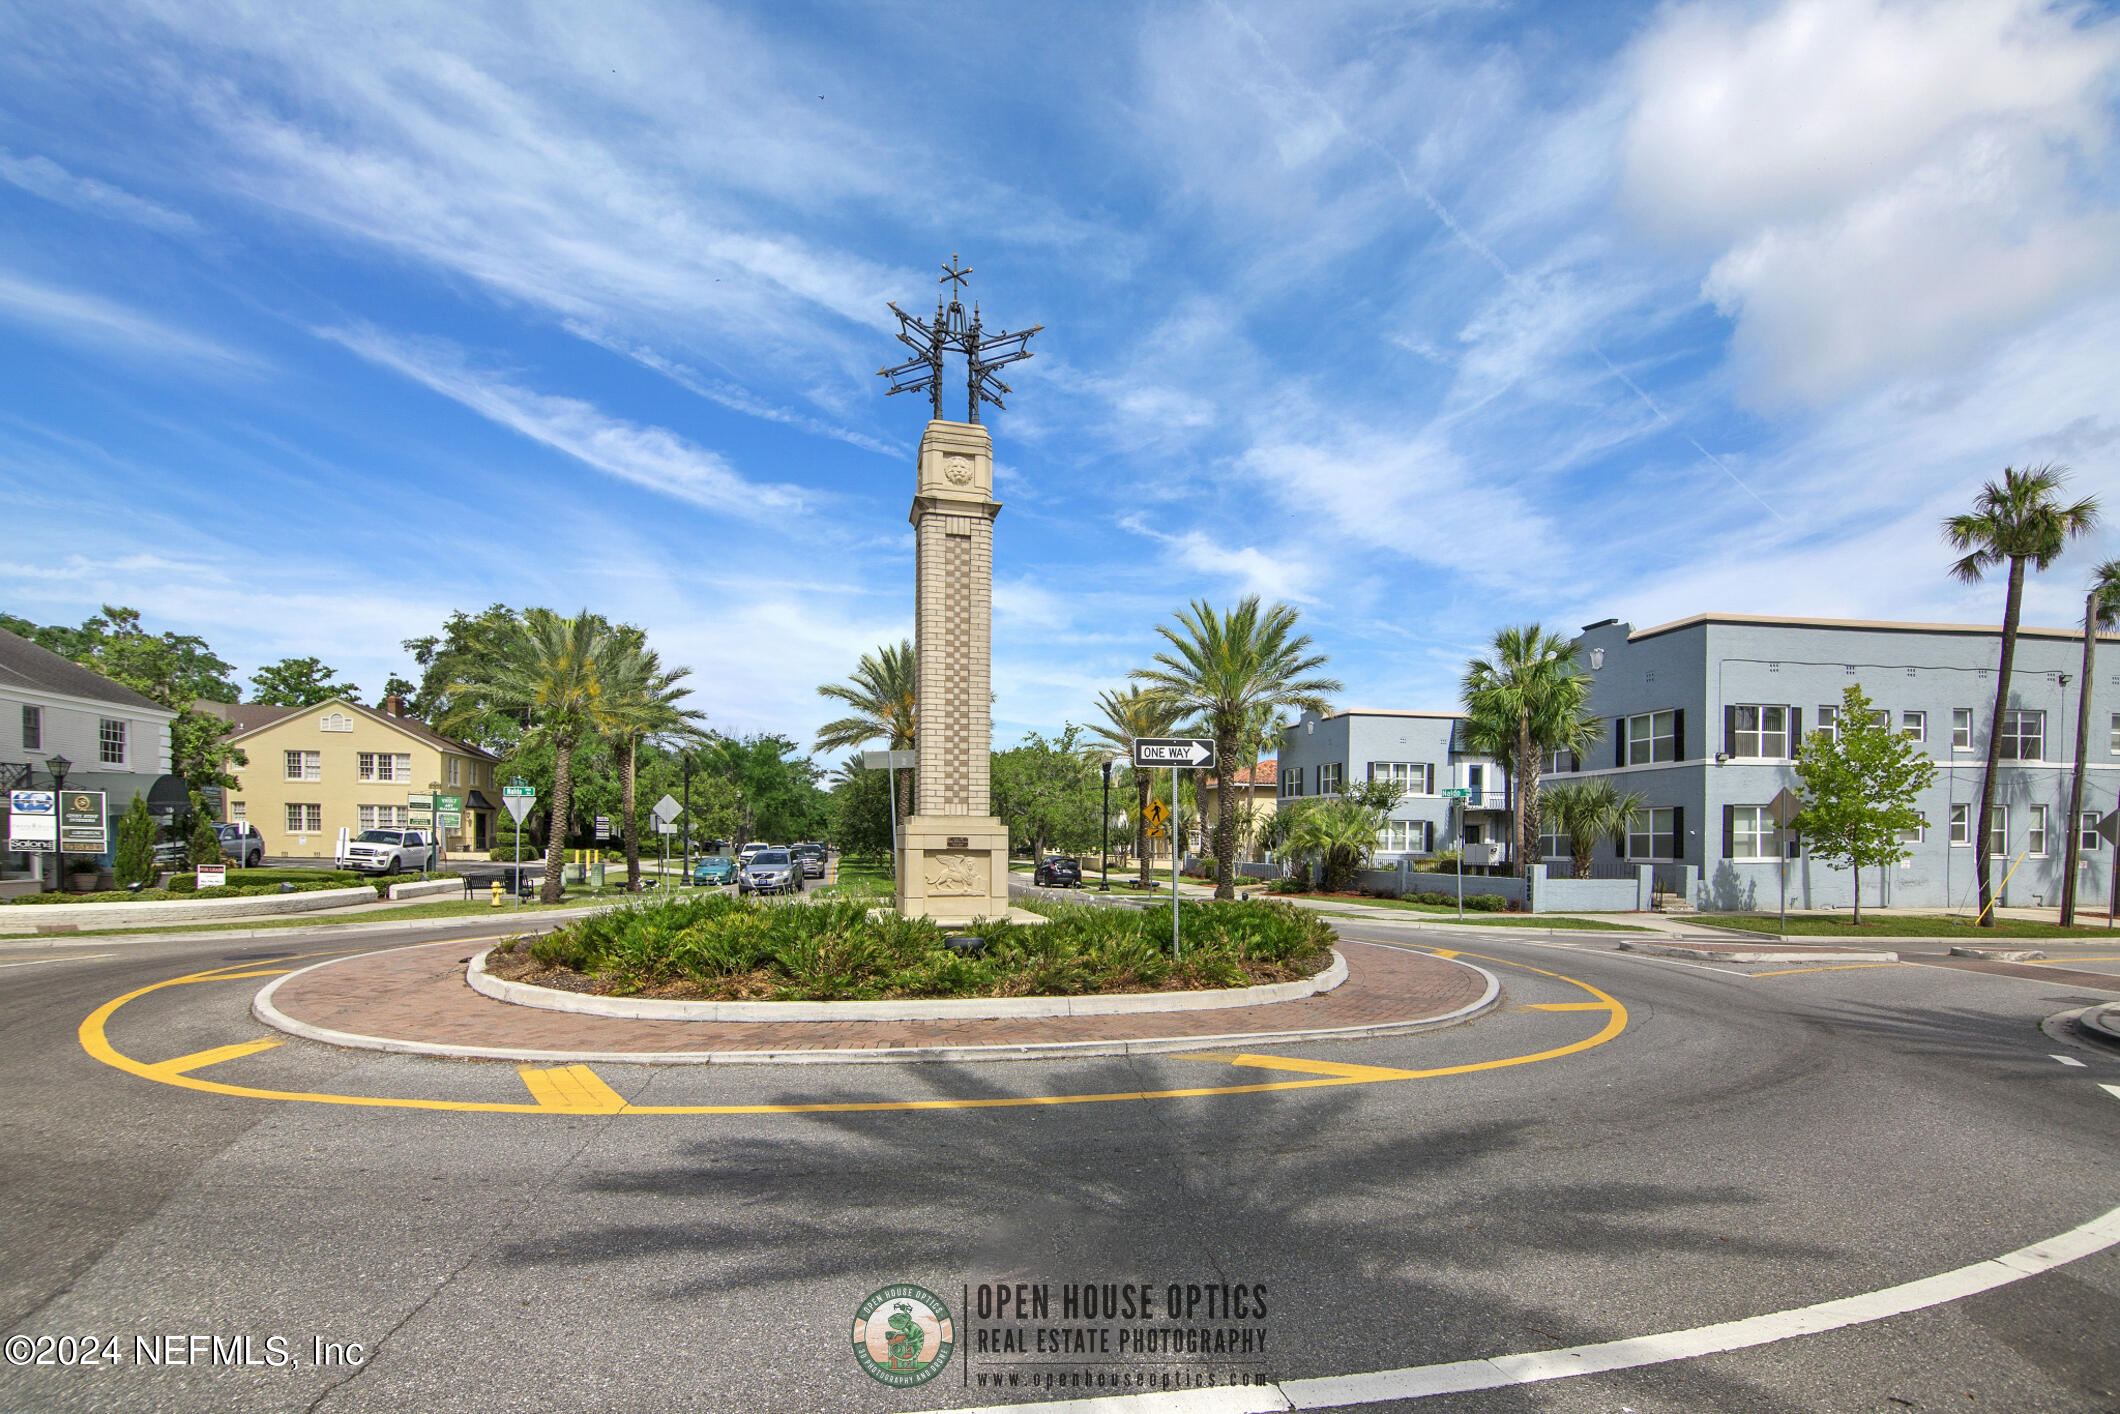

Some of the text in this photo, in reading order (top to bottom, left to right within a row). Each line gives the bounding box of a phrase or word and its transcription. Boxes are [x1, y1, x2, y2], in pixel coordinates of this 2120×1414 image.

[1144, 747, 1190, 758] ONE WAY
[11, 840, 46, 849] Salon
